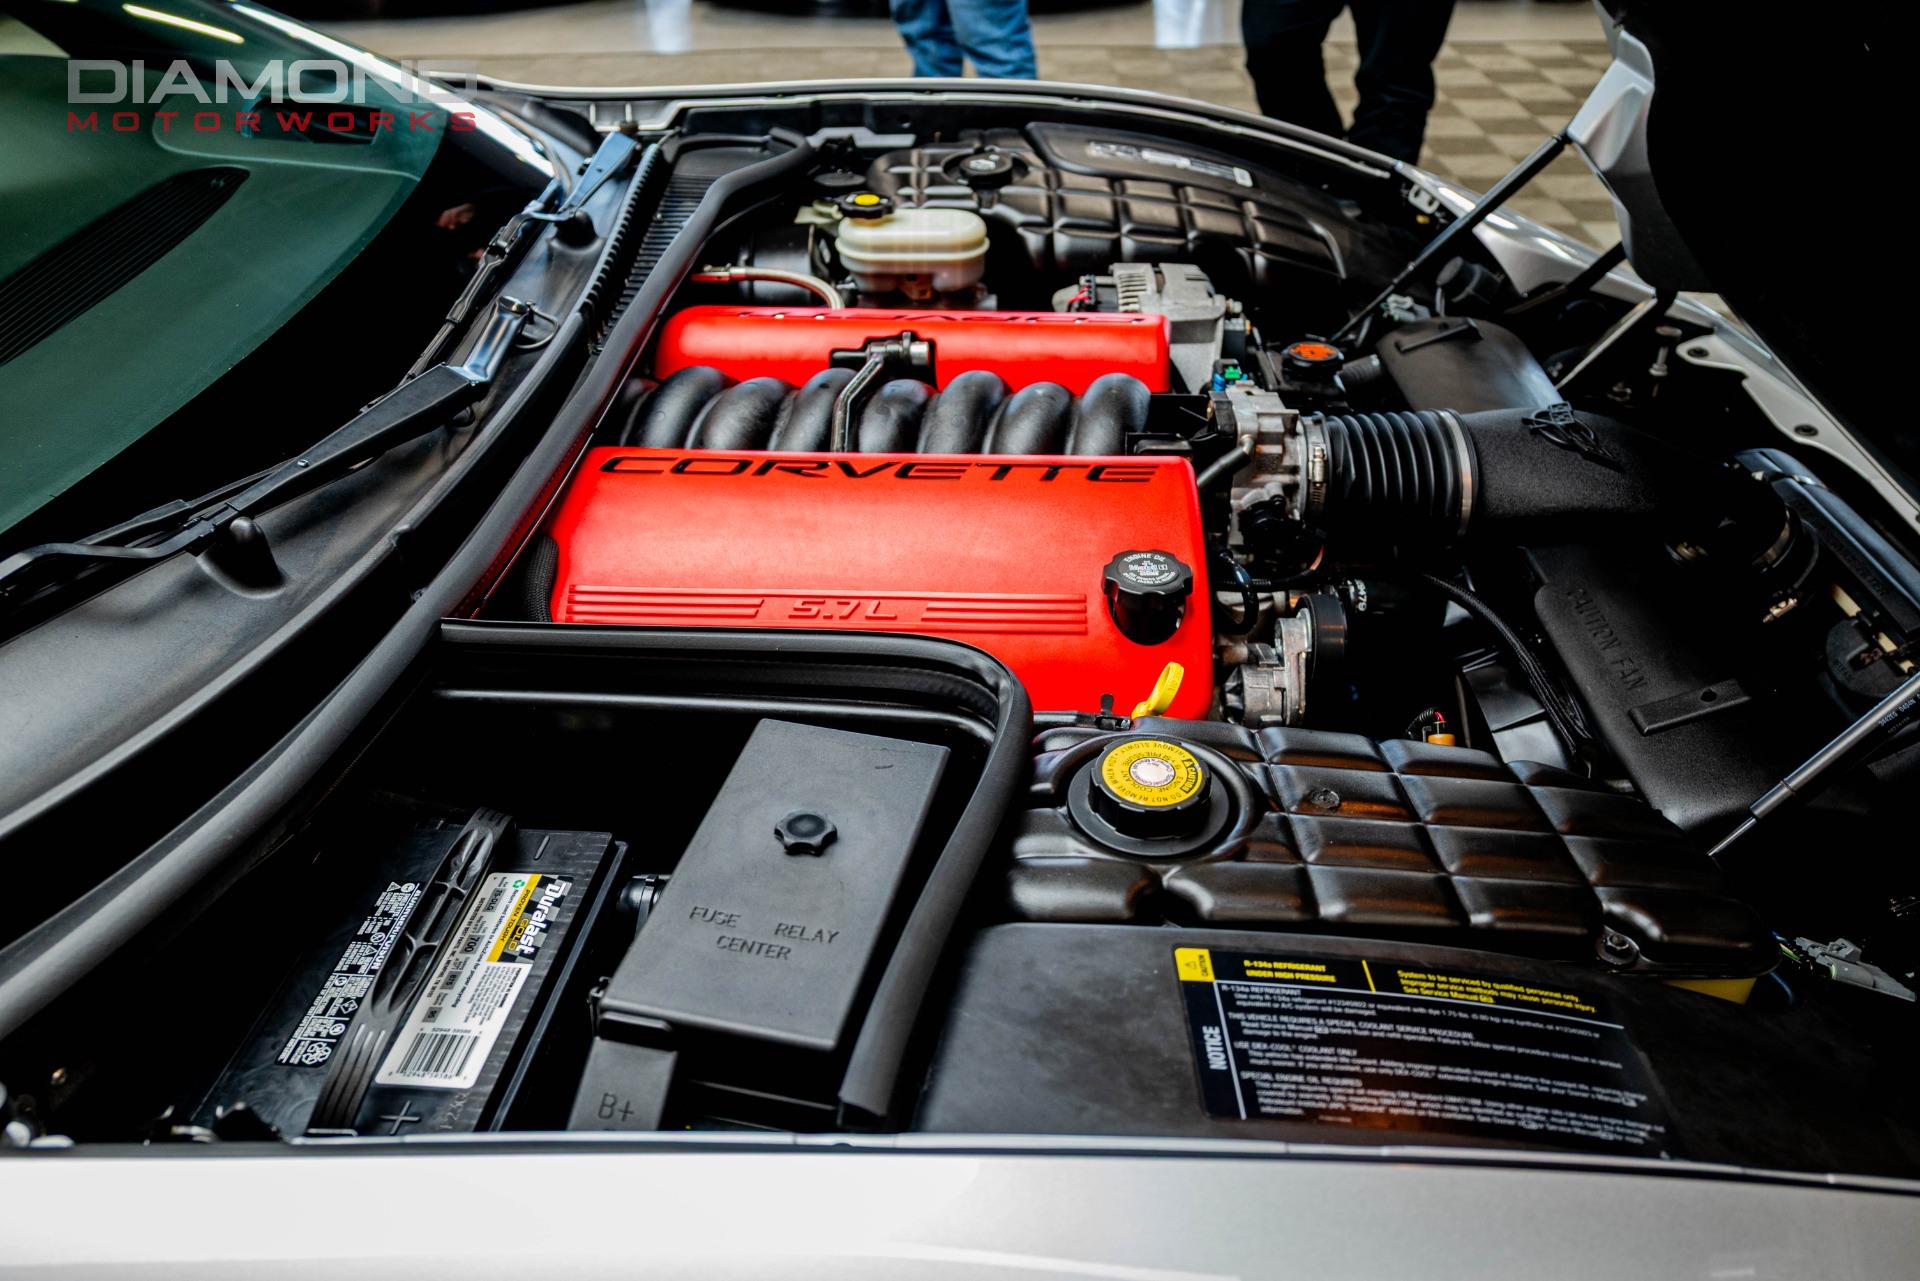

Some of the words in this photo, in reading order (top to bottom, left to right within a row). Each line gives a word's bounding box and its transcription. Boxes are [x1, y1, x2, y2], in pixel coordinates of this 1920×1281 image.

[600, 456, 1158, 483] CORVETTE
[1123, 553, 1152, 563] ENGINE
[1153, 554, 1166, 562] OIL
[788, 599, 898, 620] 5.7L
[1611, 657, 1648, 690] FAN
[1120, 742, 1150, 754] SLOWLY
[1152, 742, 1185, 757] REMOVE
[1120, 770, 1153, 793] COOLANT
[1157, 775, 1184, 793] ENGINE
[1182, 767, 1198, 792] CAUTION
[1117, 785, 1149, 801] REMOVE
[1151, 795, 1169, 803] NOT
[515, 889, 530, 916] PROVEN
[501, 918, 515, 941] TOUGH
[516, 882, 572, 954] Duralast
[689, 906, 741, 928] FUSE
[774, 922, 840, 944] RELAY
[465, 936, 479, 952] 700
[509, 917, 529, 950] GOLD
[716, 935, 792, 961] CENTER
[1273, 962, 1327, 971] REFRIGERANT
[1295, 973, 1337, 982] PRESSURE
[1397, 970, 1427, 980] System
[1448, 976, 1481, 987] serviced
[1525, 987, 1563, 999] personnel
[1400, 979, 1435, 988] Improper
[1436, 983, 1465, 992] service
[1420, 988, 1450, 997] Service
[1450, 992, 1479, 1001] Manual
[1202, 1025, 1228, 1071] NOTICE
[598, 1093, 635, 1122] B+
